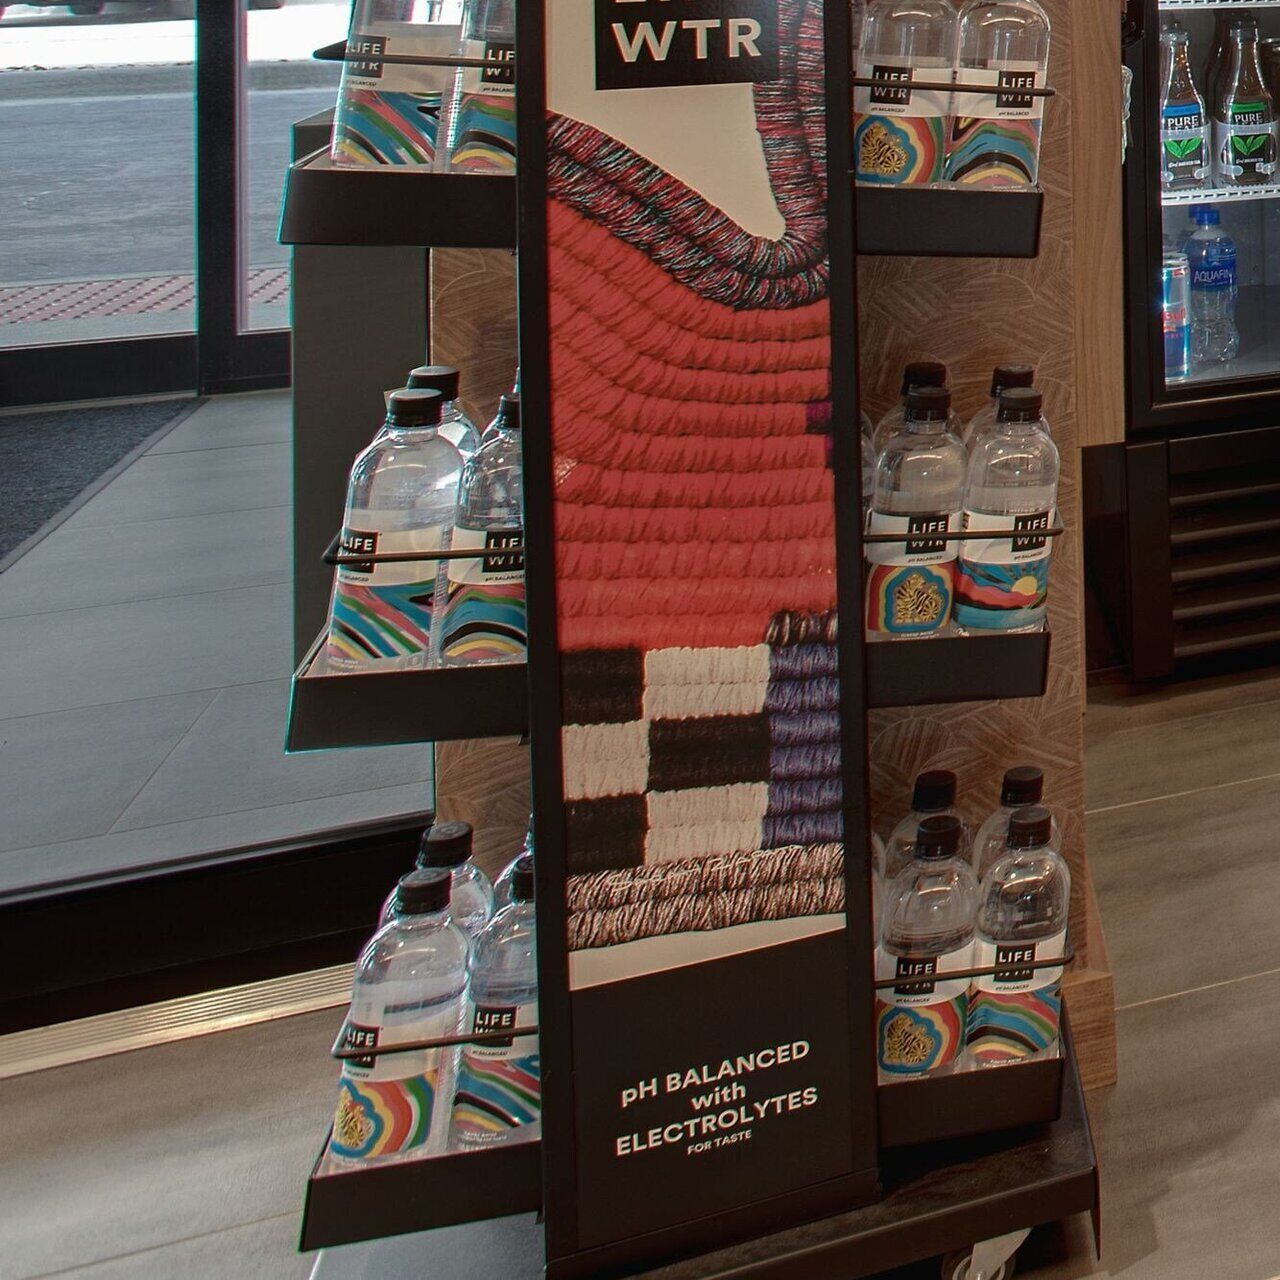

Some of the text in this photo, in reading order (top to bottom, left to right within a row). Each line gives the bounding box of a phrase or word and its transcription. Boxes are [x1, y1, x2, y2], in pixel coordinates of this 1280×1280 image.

[611, 16, 763, 64] WTR
[1002, 77, 1033, 88] LIFE
[874, 86, 907, 99] WTR
[1167, 115, 1199, 127] PURE
[1234, 112, 1263, 123] PURE
[912, 520, 946, 535] LIFE
[999, 949, 1033, 963] LIFE
[900, 963, 934, 976] LIFE
[476, 1011, 512, 1027] LIFE
[620, 1039, 812, 1108] pH BALANCED
[690, 1081, 747, 1111] with
[615, 1086, 819, 1157] ELECTROLYTES
[686, 1129, 753, 1156] FOR TASTE
